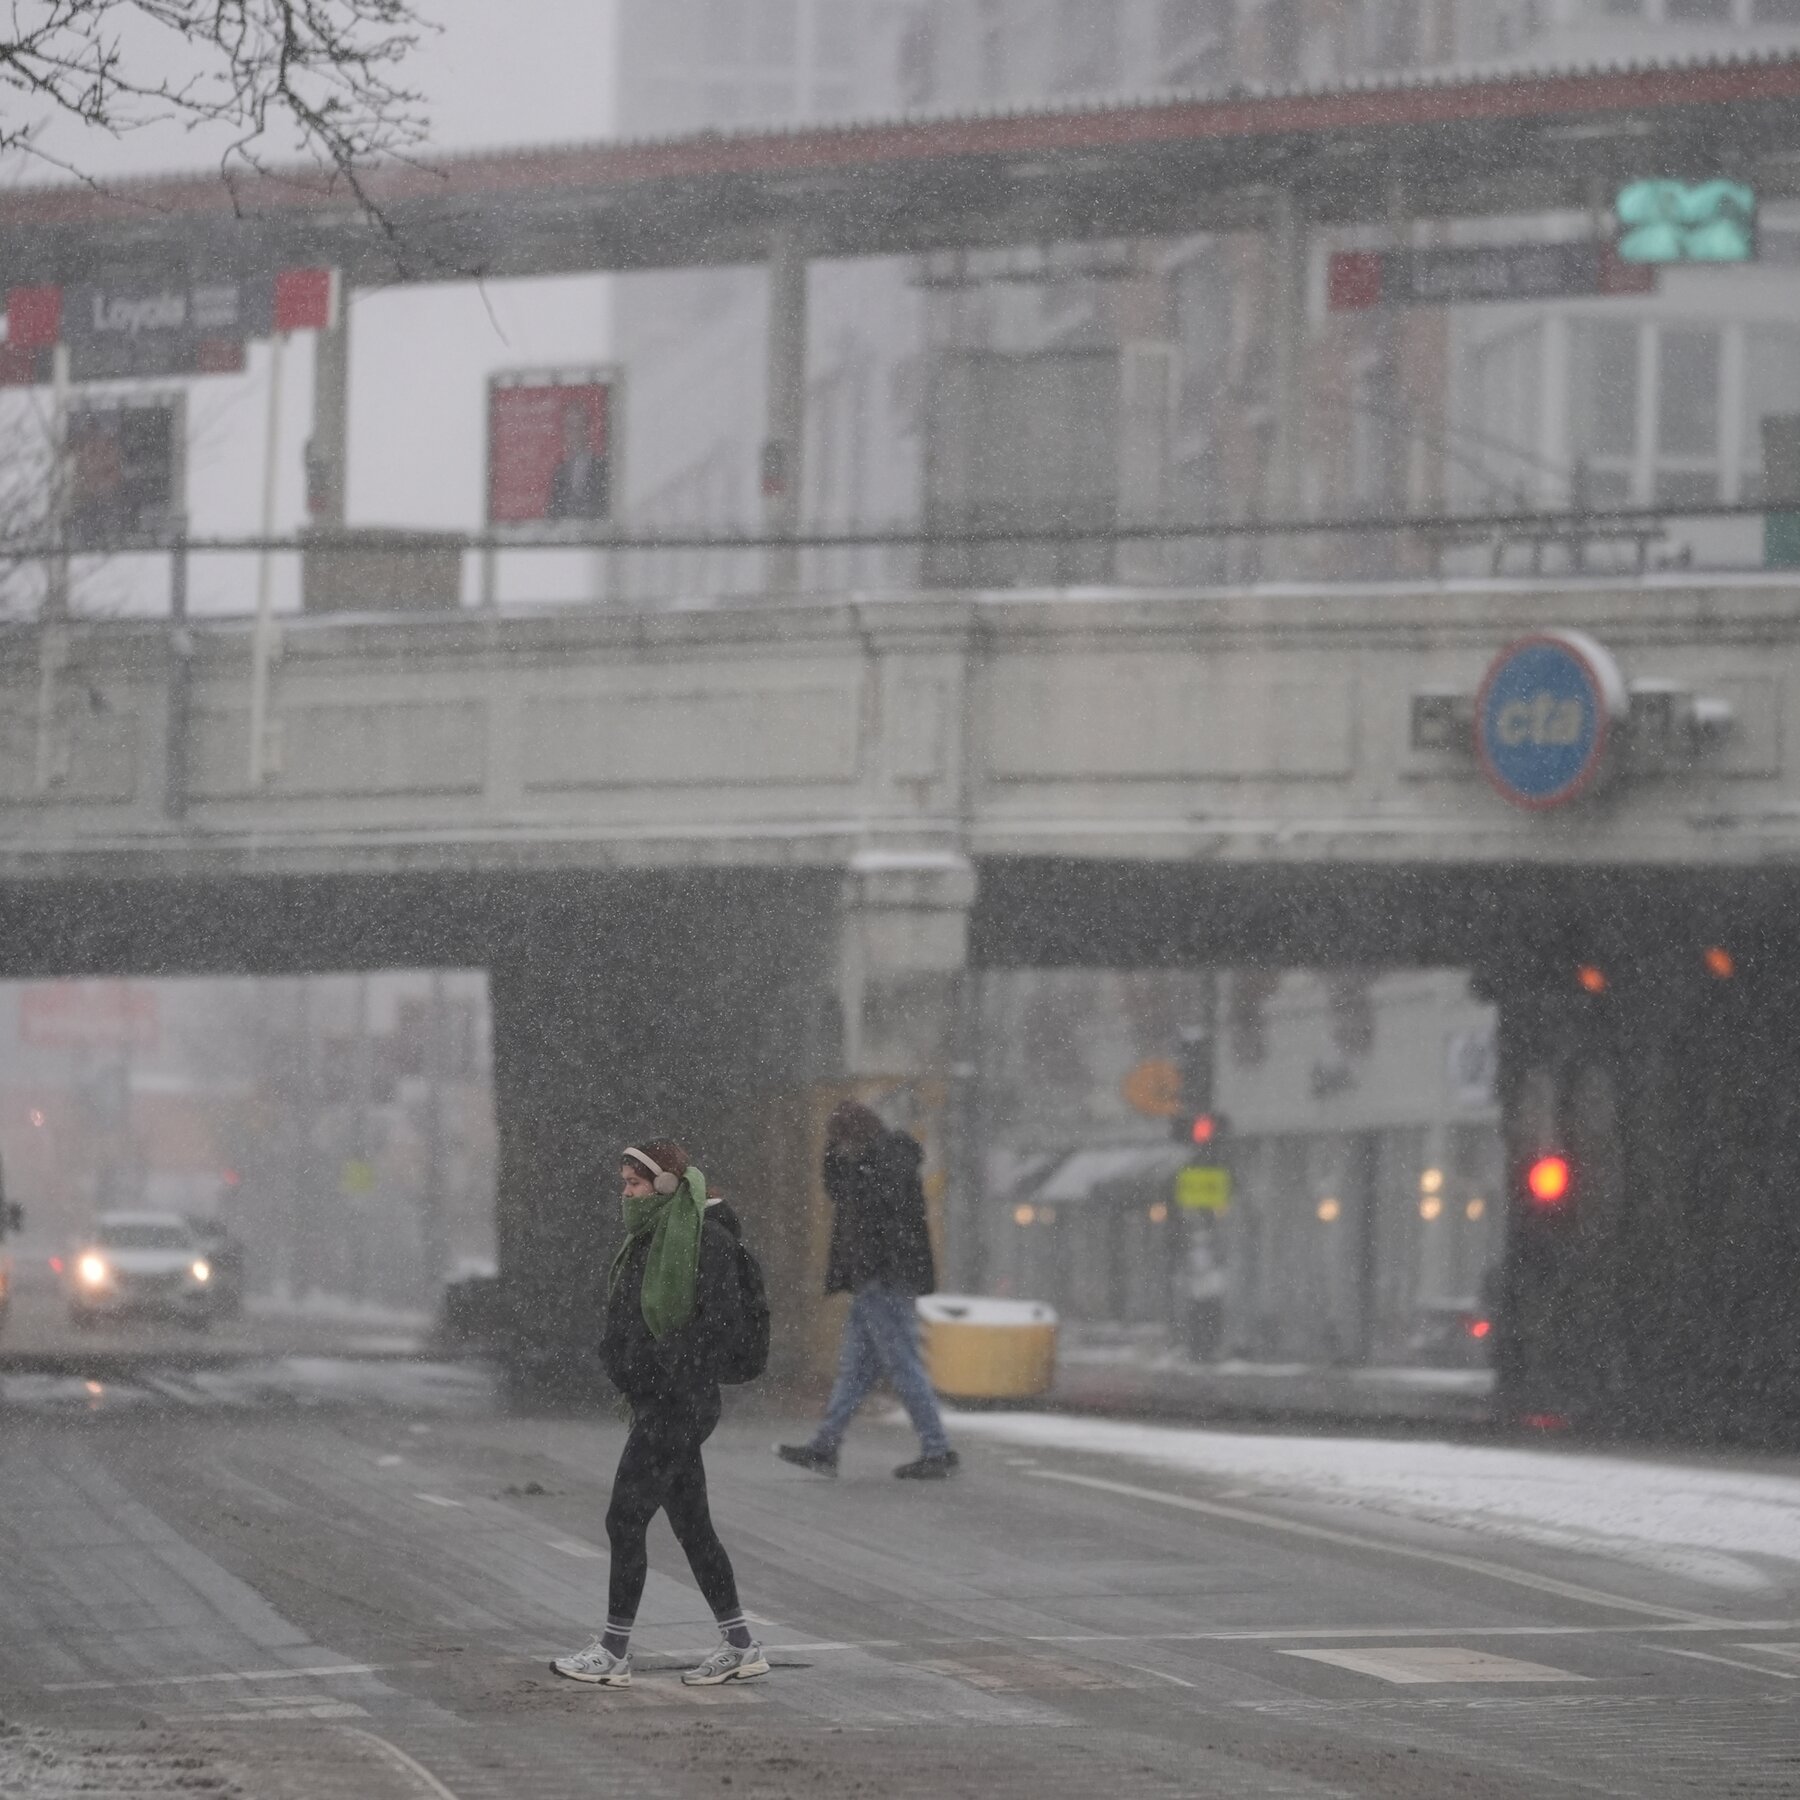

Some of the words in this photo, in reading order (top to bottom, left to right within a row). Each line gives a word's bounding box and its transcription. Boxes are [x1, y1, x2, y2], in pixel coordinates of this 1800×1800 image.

[1498, 690, 1581, 745] cta
[592, 1658, 603, 1667] N
[718, 1656, 729, 1665] N
